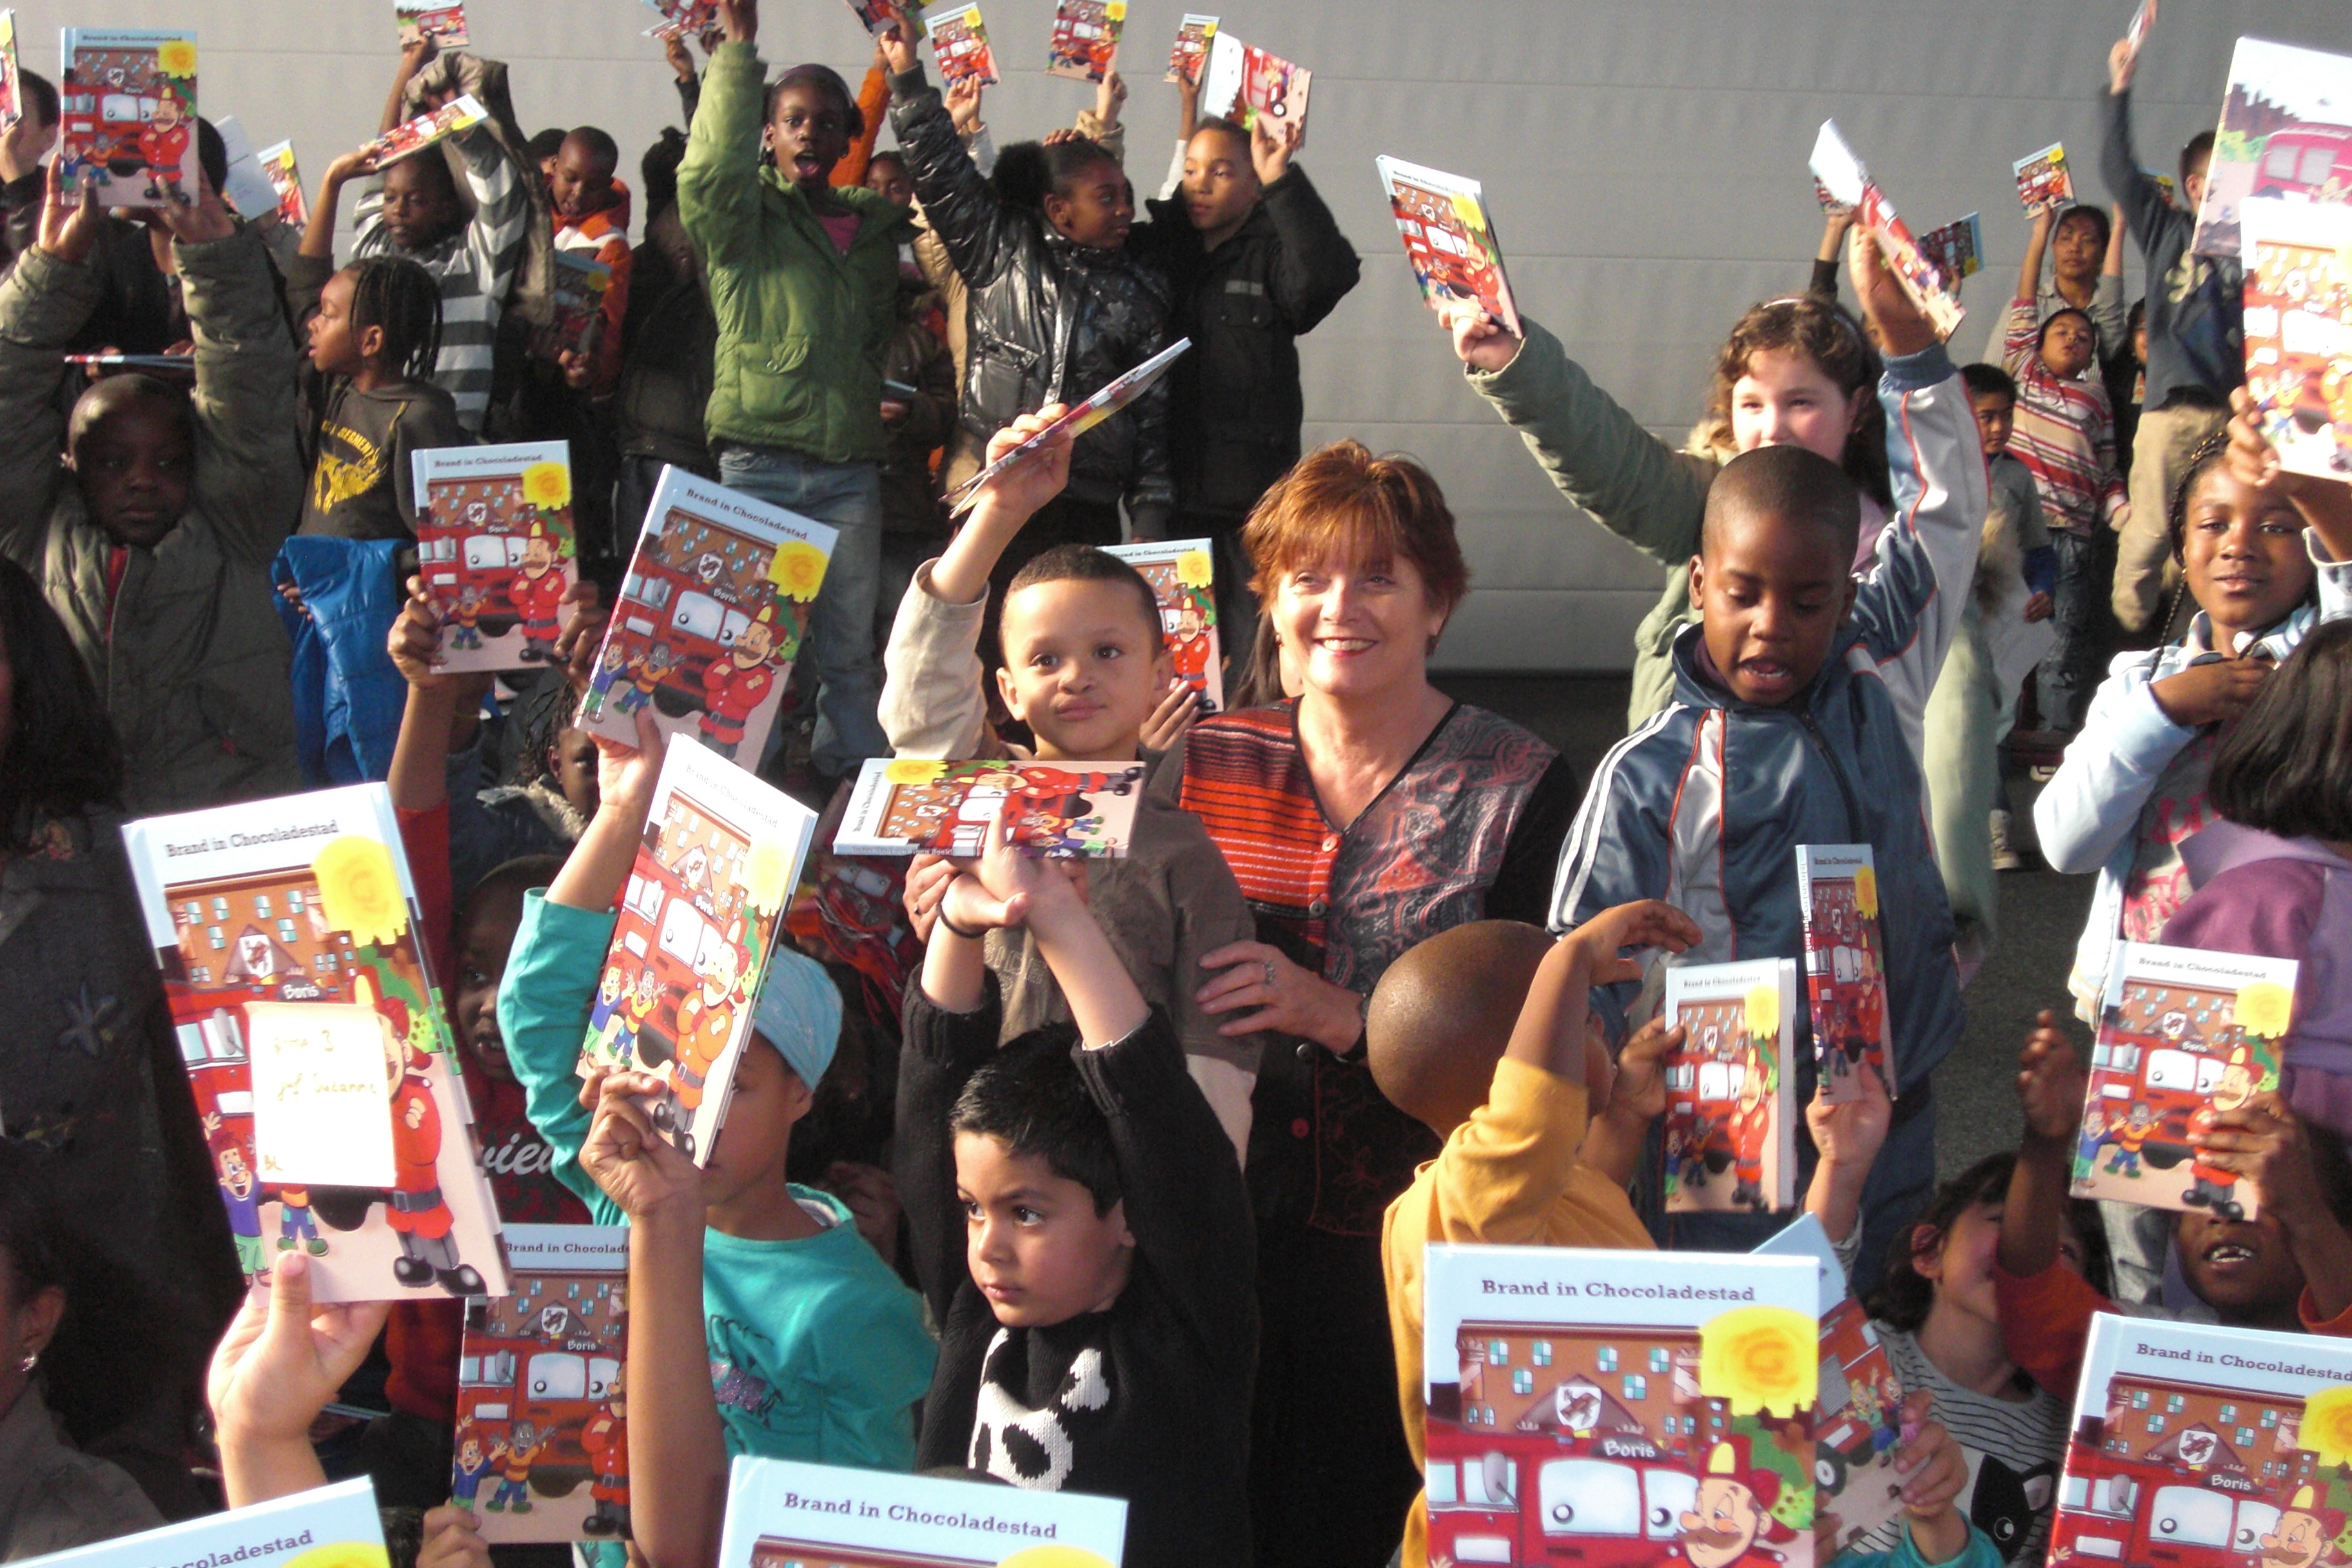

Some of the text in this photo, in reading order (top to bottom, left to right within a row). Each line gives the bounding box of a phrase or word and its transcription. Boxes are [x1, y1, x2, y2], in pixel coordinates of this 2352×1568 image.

[686, 488, 808, 540] Brand in Chocoladestad
[713, 587, 738, 604] Boris
[165, 819, 340, 858] Brand in Chocoladestad
[282, 983, 320, 999] Boris
[505, 1242, 544, 1253] Brand
[547, 1244, 560, 1253] in
[1482, 1279, 1756, 1302] Brand in Chocoladestad
[567, 1340, 597, 1351] Boris
[2136, 1343, 2352, 1382] Brand in Chocoladestad
[1603, 1440, 1656, 1458] Boris
[2211, 1474, 2251, 1491] Boris
[783, 1492, 1058, 1540] Brand in Chocoladestad
